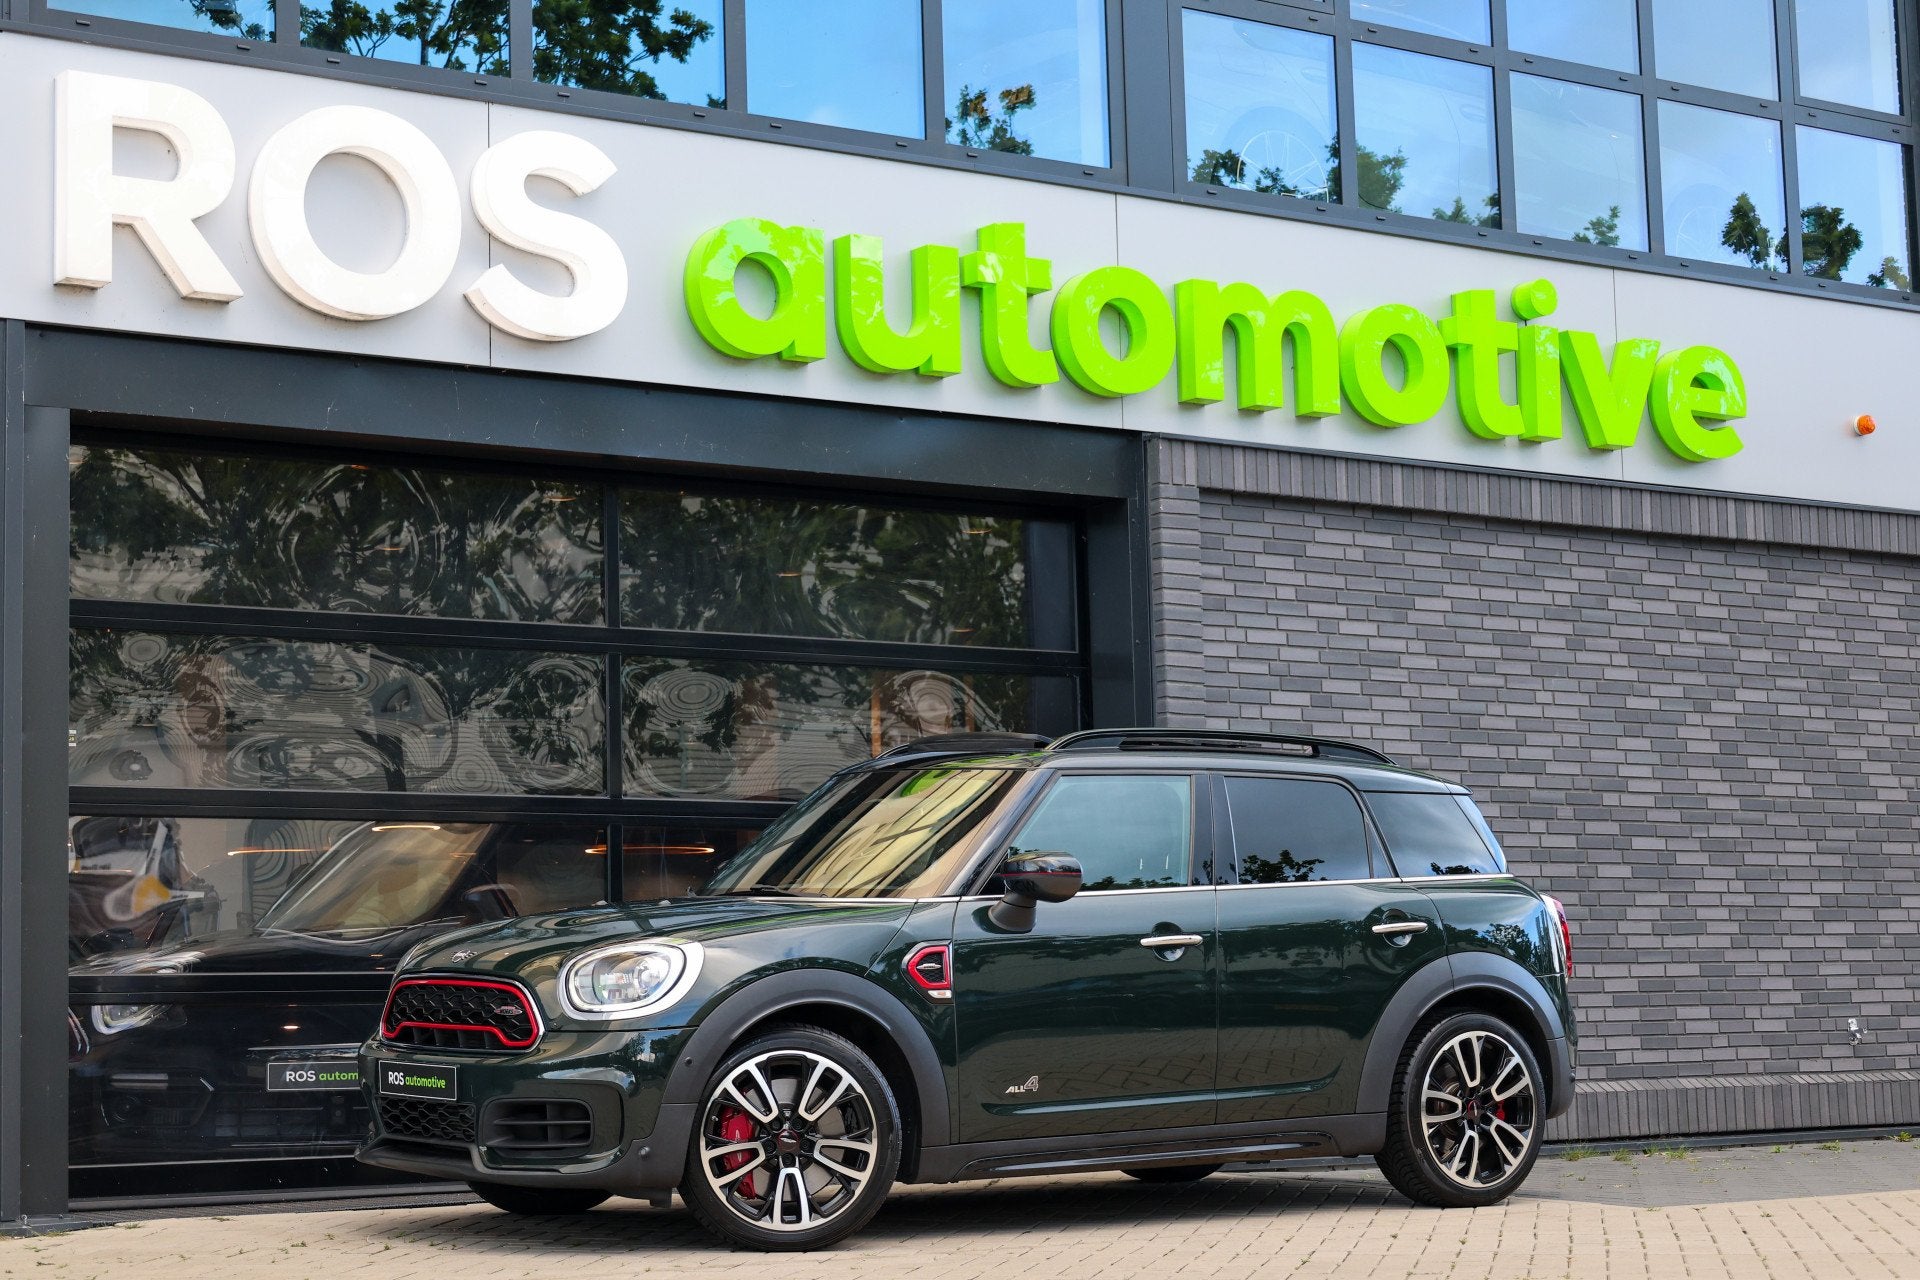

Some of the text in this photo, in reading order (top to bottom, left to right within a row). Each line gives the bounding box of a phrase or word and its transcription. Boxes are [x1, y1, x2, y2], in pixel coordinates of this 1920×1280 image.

[52, 69, 1747, 463] ROS automotive
[285, 1070, 359, 1082] ROS autom
[388, 1071, 446, 1089] ROS automotive
